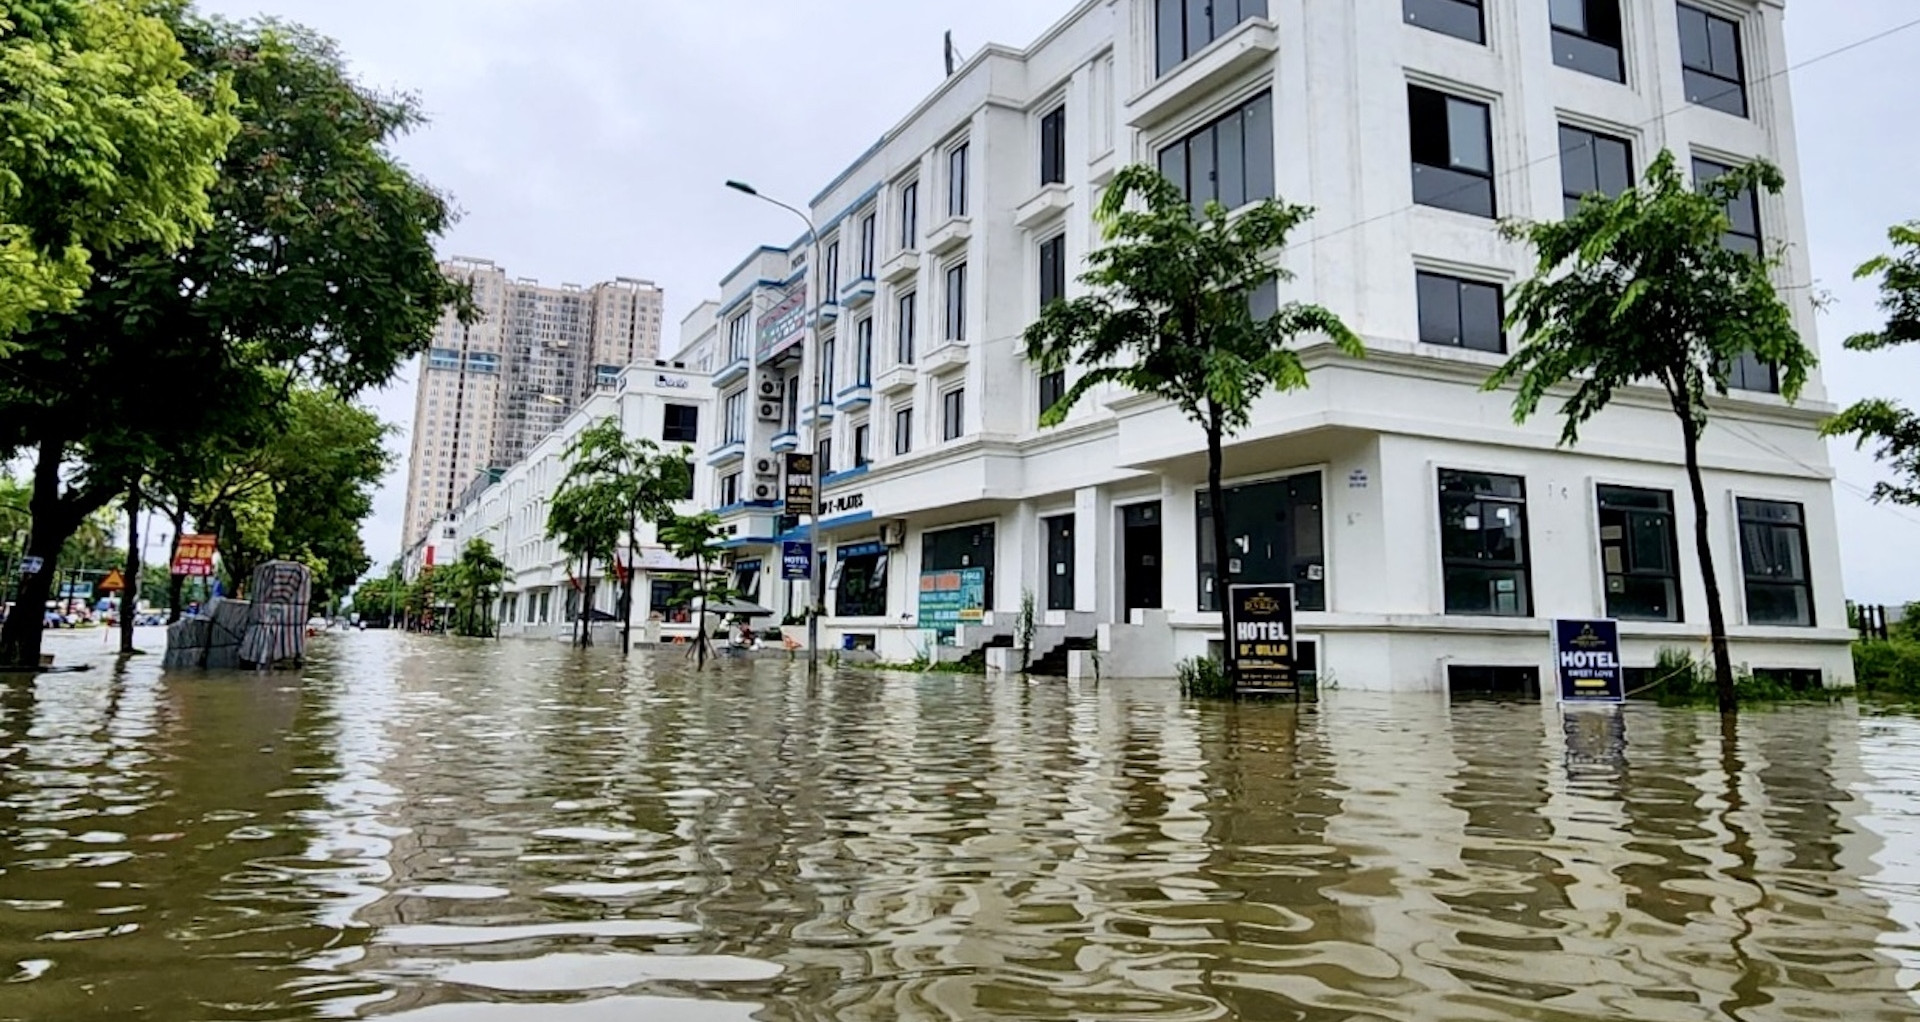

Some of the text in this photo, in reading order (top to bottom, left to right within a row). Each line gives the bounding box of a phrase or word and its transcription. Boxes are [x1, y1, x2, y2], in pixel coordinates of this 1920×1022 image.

[784, 555, 809, 565] HOTEL
[1237, 622, 1289, 640] HOTEL
[1560, 651, 1618, 668] HOTEL
[1567, 669, 1614, 678] SWEET LOVE
